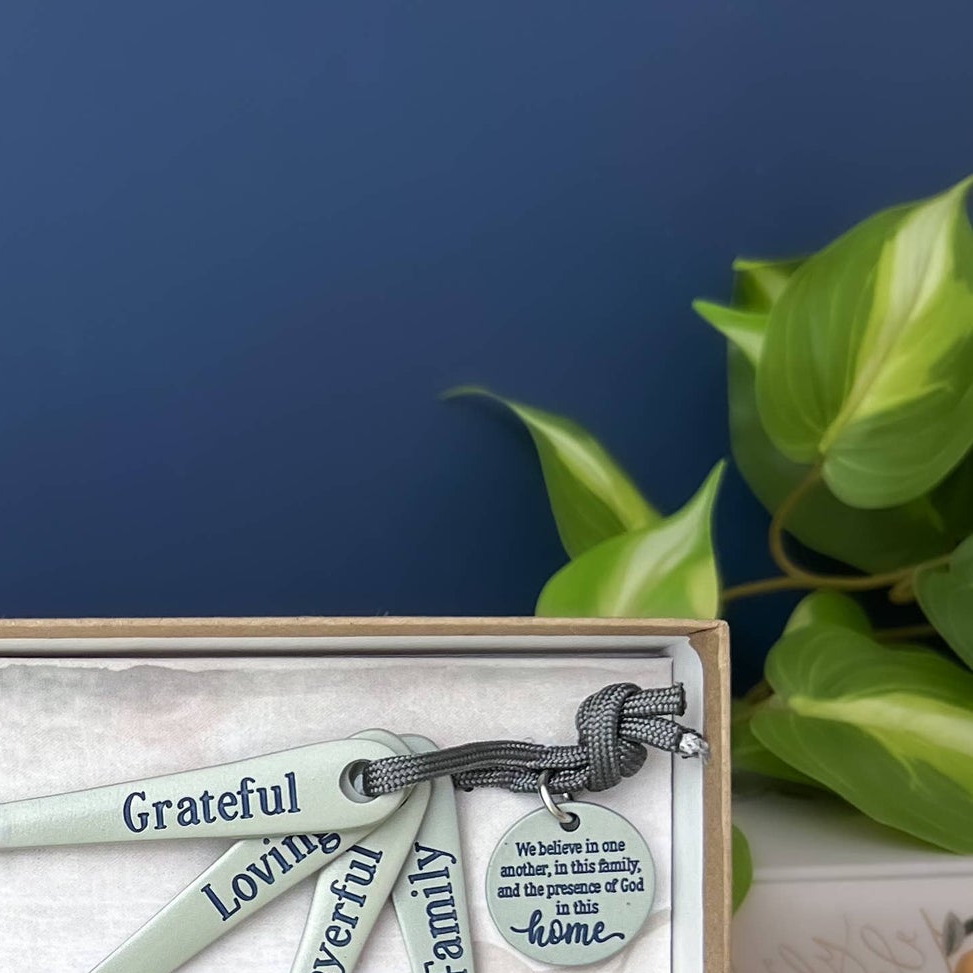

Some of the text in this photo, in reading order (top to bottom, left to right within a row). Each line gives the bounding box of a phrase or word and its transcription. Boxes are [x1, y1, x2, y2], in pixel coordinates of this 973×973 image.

[123, 772, 301, 833] Grateful
[516, 839, 625, 856] We believe in one
[201, 833, 342, 921] Loving
[500, 857, 642, 878] another, in this family,
[497, 877, 644, 899] and the presence of God
[556, 900, 599, 915] in this
[510, 910, 625, 947] home
